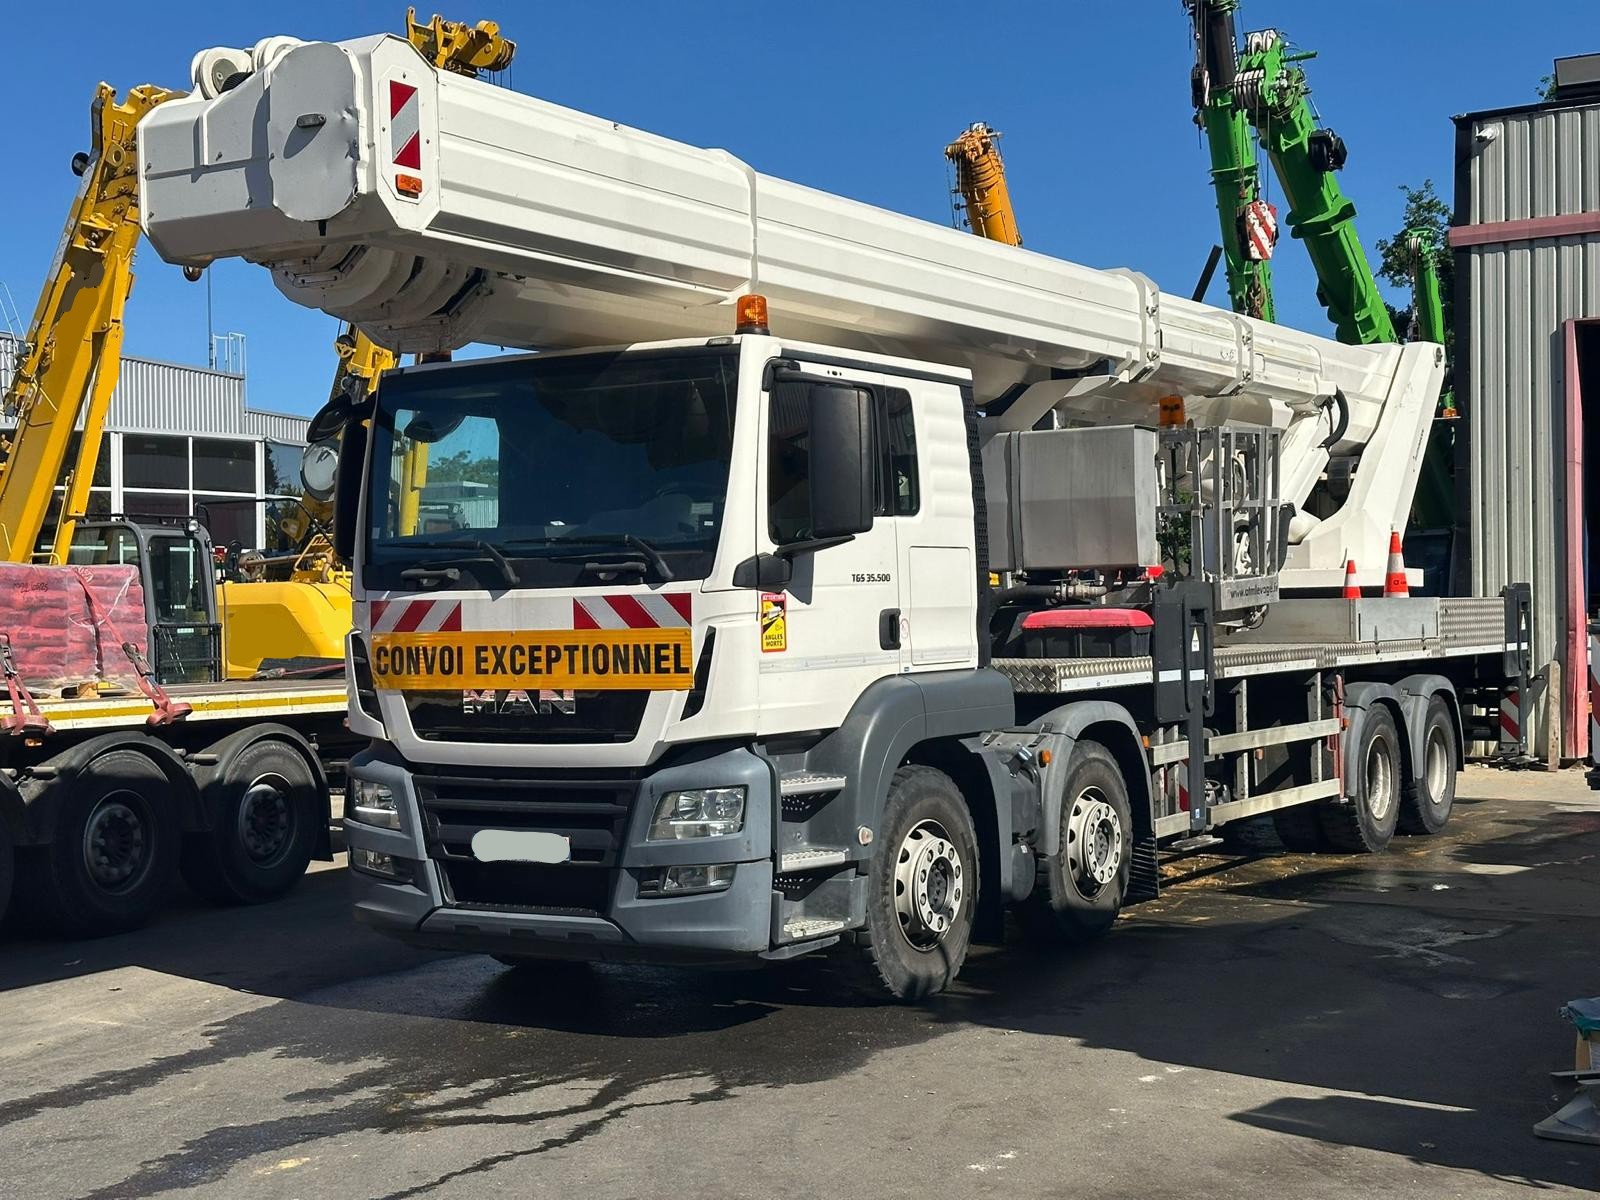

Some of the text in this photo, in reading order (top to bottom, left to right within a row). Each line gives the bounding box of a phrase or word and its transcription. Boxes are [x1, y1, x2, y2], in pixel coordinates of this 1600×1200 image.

[866, 573, 891, 582] 35.500
[765, 633, 783, 641] ANGLES
[376, 643, 690, 675] CONVOI EXCEPTIONNEL
[463, 688, 576, 714] MAN
